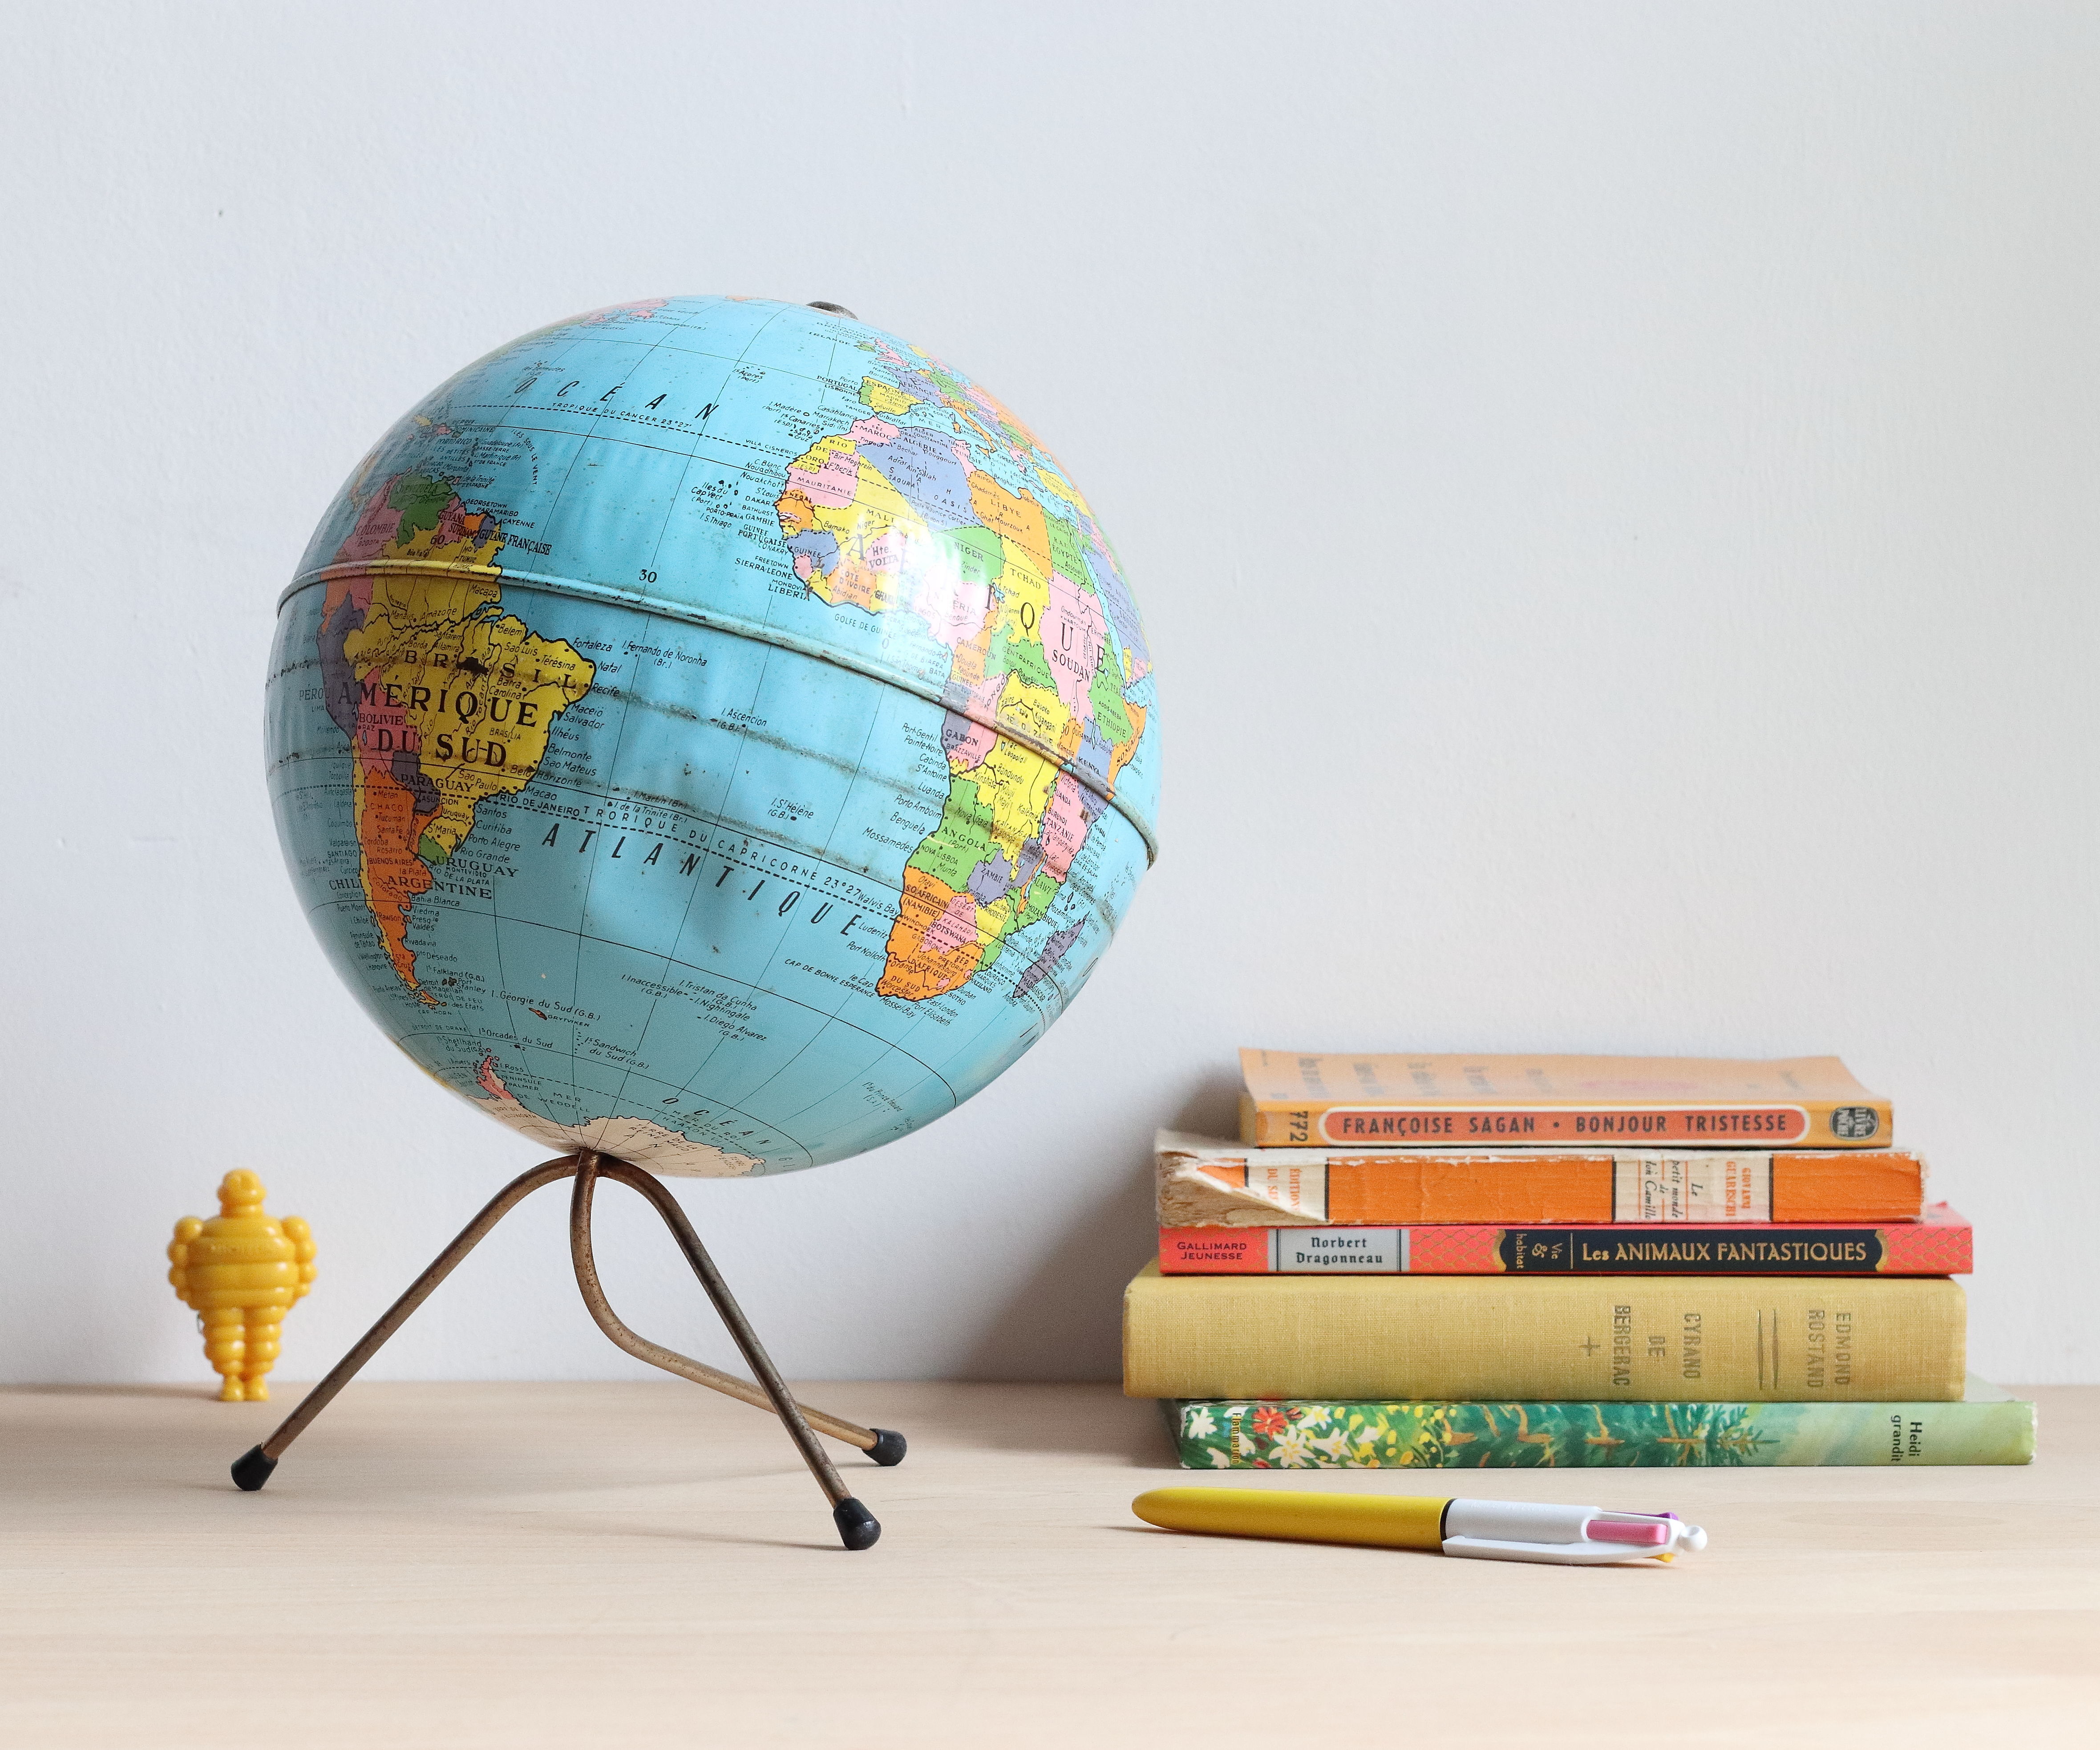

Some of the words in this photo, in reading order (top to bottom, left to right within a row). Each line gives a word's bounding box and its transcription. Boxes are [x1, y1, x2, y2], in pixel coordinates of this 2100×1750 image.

[817, 375, 858, 391] PORTUGAL
[824, 384, 858, 397] LISBONNE
[552, 402, 598, 413] TROPIQUE
[621, 411, 657, 422] CANCER
[812, 411, 850, 426] Marrakech
[817, 404, 858, 421] Casablanca
[859, 425, 893, 440] MAROC
[745, 439, 762, 447] VILLA
[764, 444, 798, 457] CISNEROS
[815, 445, 828, 454] DE
[829, 439, 848, 449] RIO
[805, 454, 825, 464] ORO
[745, 462, 786, 478] Nouadhibou
[740, 471, 785, 488] Nouakchott
[797, 476, 852, 496] MAURITANIE
[465, 498, 508, 508] GEORGETOWN
[745, 495, 770, 506] DAKAR
[990, 498, 1021, 518] LIBYE
[477, 506, 519, 517] PARAMARIBO
[742, 505, 774, 517] BATHURST
[745, 513, 776, 527] GAMBIE
[866, 508, 894, 523] MALI
[502, 517, 535, 529] CAYENNE
[430, 535, 445, 546] 60
[507, 534, 552, 556] FRANÇAISE
[737, 529, 787, 548] PORTUGAISE
[758, 543, 789, 556] CONAKRY
[954, 541, 983, 563] NIGER
[755, 555, 789, 569] FREETOWN
[639, 569, 657, 583] 30
[1010, 568, 1041, 590] TCHAD
[768, 584, 809, 601] LIBERIA
[498, 623, 523, 638] Belem
[573, 638, 612, 652] Fortaleza
[956, 637, 996, 660] CAMEROUN
[598, 661, 622, 673] Natal
[663, 649, 672, 659] de
[675, 650, 707, 667] Noronha
[1052, 649, 1091, 682] SOUDAN
[591, 682, 619, 697] Recife
[338, 675, 538, 727] AMÉRIQUE
[358, 713, 404, 725] BOLIVIE
[563, 712, 605, 729] Salvador
[728, 709, 767, 727] Ascencion
[1097, 712, 1127, 739] ETHIOPIE
[551, 725, 580, 741] Ilhéus
[946, 729, 979, 746] GABON
[377, 729, 418, 752] DU
[435, 733, 507, 768] SUD
[547, 743, 592, 761] Belmonte
[542, 756, 561, 768] Sao
[562, 760, 597, 777] Mateus
[401, 773, 475, 793] PARAGUAY
[458, 770, 475, 780] Sao
[474, 777, 497, 791] Paulo
[526, 785, 557, 801] Macao
[918, 782, 945, 800] Luanda
[476, 804, 507, 818] Santos
[500, 793, 519, 804] RIO
[522, 798, 536, 807] DE
[537, 803, 580, 817] JANEIRO
[894, 794, 914, 809] Porto
[913, 801, 943, 819] Amboim
[476, 820, 512, 835] Curitiba
[890, 812, 926, 836] Benguela
[468, 834, 489, 847] Porto
[490, 838, 521, 852] Alegre
[862, 827, 914, 853] Mossamedes
[942, 826, 987, 851] ANGOLA
[460, 847, 473, 857] Rio
[474, 848, 510, 864] Grande
[689, 829, 707, 842] DU
[718, 839, 817, 880] CAPRICORNE
[435, 855, 519, 879] URUGUAY
[981, 866, 1003, 883] ZAMBIE
[329, 879, 362, 890] CHILI
[388, 875, 492, 900] ARGENTINE
[542, 822, 862, 936] ATLANTIQUE
[411, 895, 433, 906] Bahia
[434, 896, 460, 907] Blanca
[857, 891, 883, 909] Walvis
[883, 903, 899, 916] Bay
[858, 922, 888, 939] Luderitz
[931, 921, 967, 944] BOTSWANA
[405, 938, 437, 948] Rivadavia
[847, 941, 864, 953] Port
[863, 947, 886, 961] Nolloth
[785, 959, 801, 967] CAP
[801, 964, 814, 972] DE
[814, 967, 839, 982] BONNE
[839, 980, 876, 998] ESPERANCE
[538, 997, 552, 1008] du
[554, 1001, 573, 1013] Sud
[716, 990, 729, 1000] da
[729, 994, 758, 1011] Cunha
[1289, 1111, 1309, 1142] 772
[1343, 1117, 1453, 1138] FRANÇOISE
[1469, 1118, 1535, 1133] SAGAN
[1576, 1115, 1667, 1133] BONJOUR
[1685, 1114, 1786, 1131] TRISTESSE
[1672, 1161, 1683, 1183] petit
[1290, 1168, 1302, 1210] ÉDITION
[1660, 1184, 1668, 1194] de
[1691, 1183, 1703, 1196] Le
[1672, 1187, 1683, 1218] monde
[1177, 1242, 1247, 1251] GALLIMARD
[1311, 1236, 1368, 1248] Norbert
[1516, 1233, 1527, 1268] habitat
[1532, 1243, 1548, 1258] &
[1551, 1243, 1563, 1259] Vie
[1181, 1251, 1243, 1260] JEUNESSE
[1296, 1252, 1383, 1265] Dragonneau
[1582, 1242, 1609, 1261] Les
[1615, 1243, 1711, 1262] ANIMAUX
[1718, 1242, 1867, 1261] FANTASTIQUES
[1612, 1305, 1631, 1386] BERGERAC
[1649, 1335, 1666, 1358] DE
[1683, 1313, 1701, 1380] CYRANO
[1807, 1309, 1825, 1388] ROSTAND
[1835, 1312, 1851, 1386] EDMOND
[1232, 1413, 1242, 1464] Flammarion
[1891, 1415, 1904, 1462] grandit
[1909, 1422, 1922, 1456] Heidi
